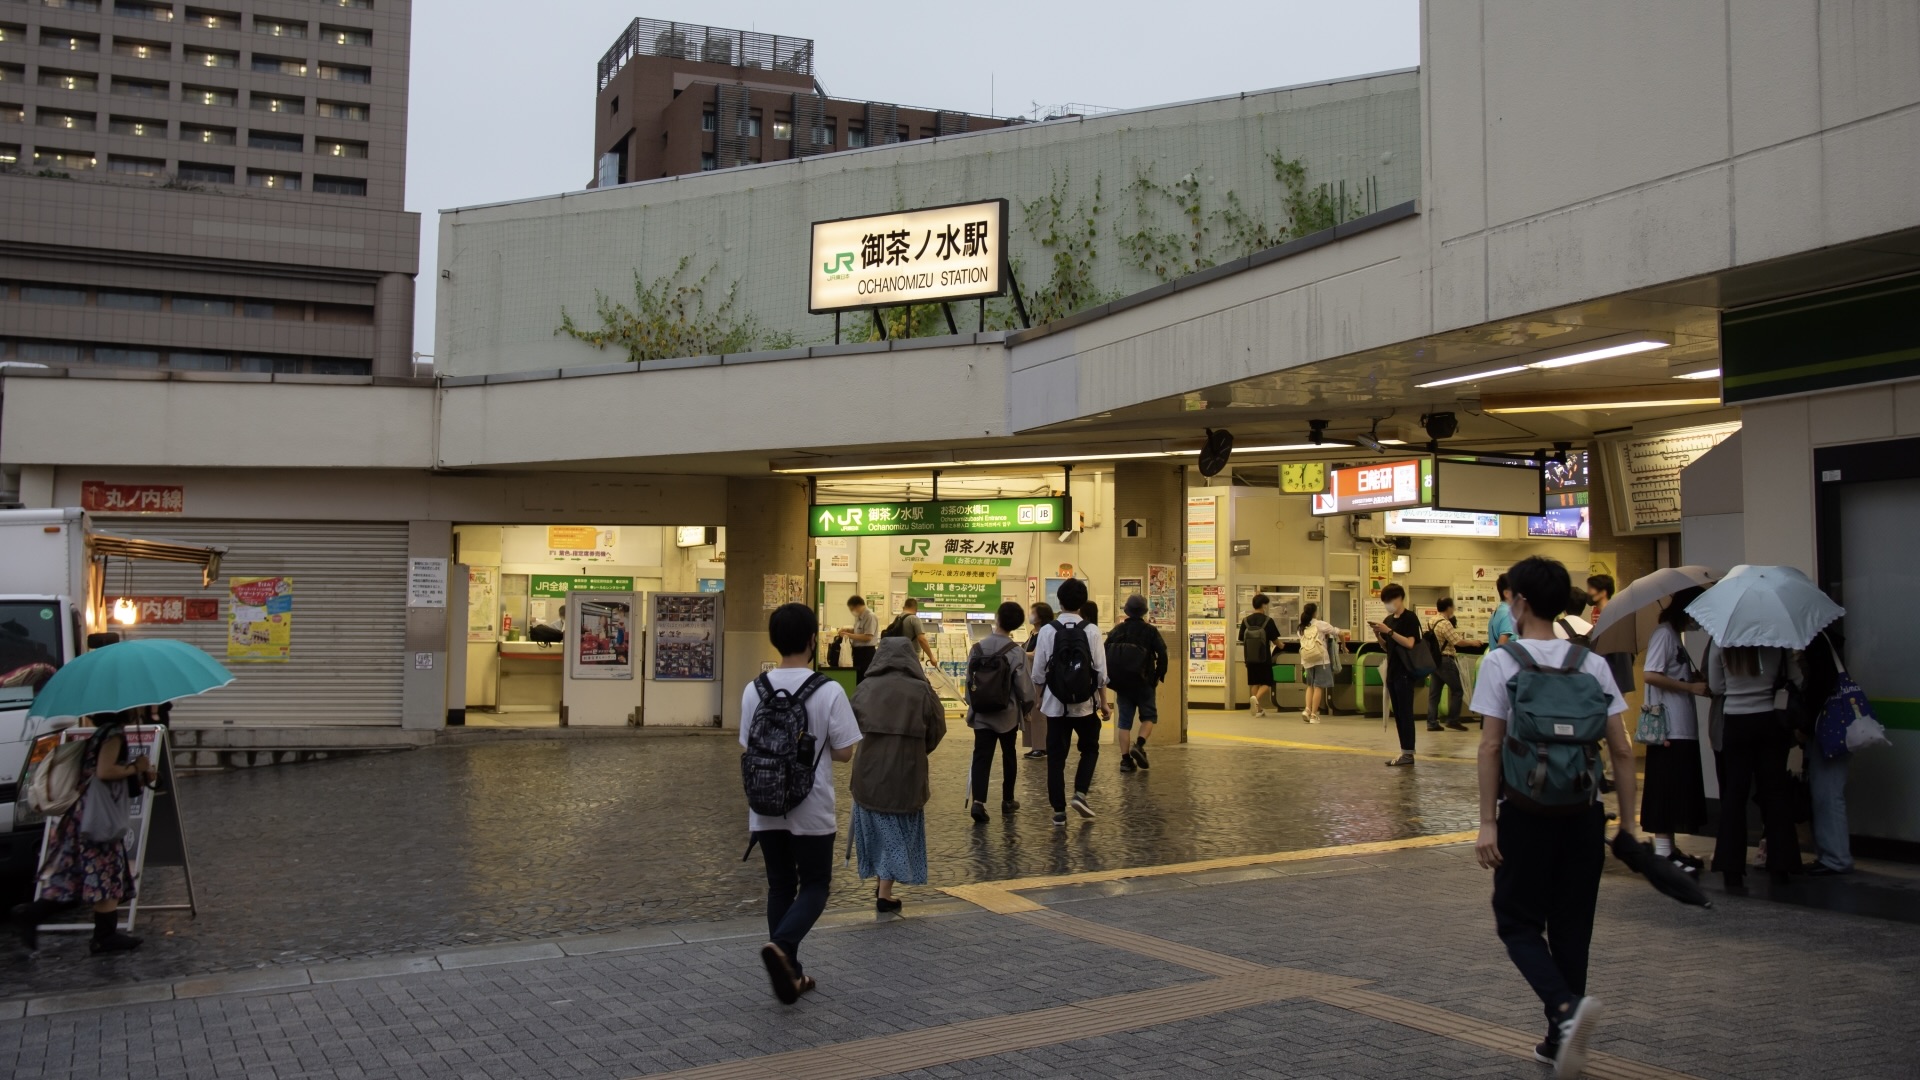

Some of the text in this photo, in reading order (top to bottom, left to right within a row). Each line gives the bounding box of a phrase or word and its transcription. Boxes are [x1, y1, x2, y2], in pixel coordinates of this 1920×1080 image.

[861, 220, 988, 269] 御茶ノ水駅
[823, 251, 854, 274] JR
[858, 266, 988, 295] OCHANOMIZU STATION
[1358, 466, 1392, 492] 日能研
[105, 488, 183, 509] 丸ノ内線
[837, 508, 863, 525] JR
[868, 507, 924, 521] 御茶ノ水駅
[940, 504, 990, 515] お茶の水橋口
[868, 522, 935, 531] Ochanomizu Station
[899, 538, 930, 556] JR
[944, 538, 1015, 555] 御茶ノ水駅
[582, 566, 586, 575] 1
[535, 581, 569, 592] JR全線
[924, 583, 986, 592] JR線 きっぷうりば
